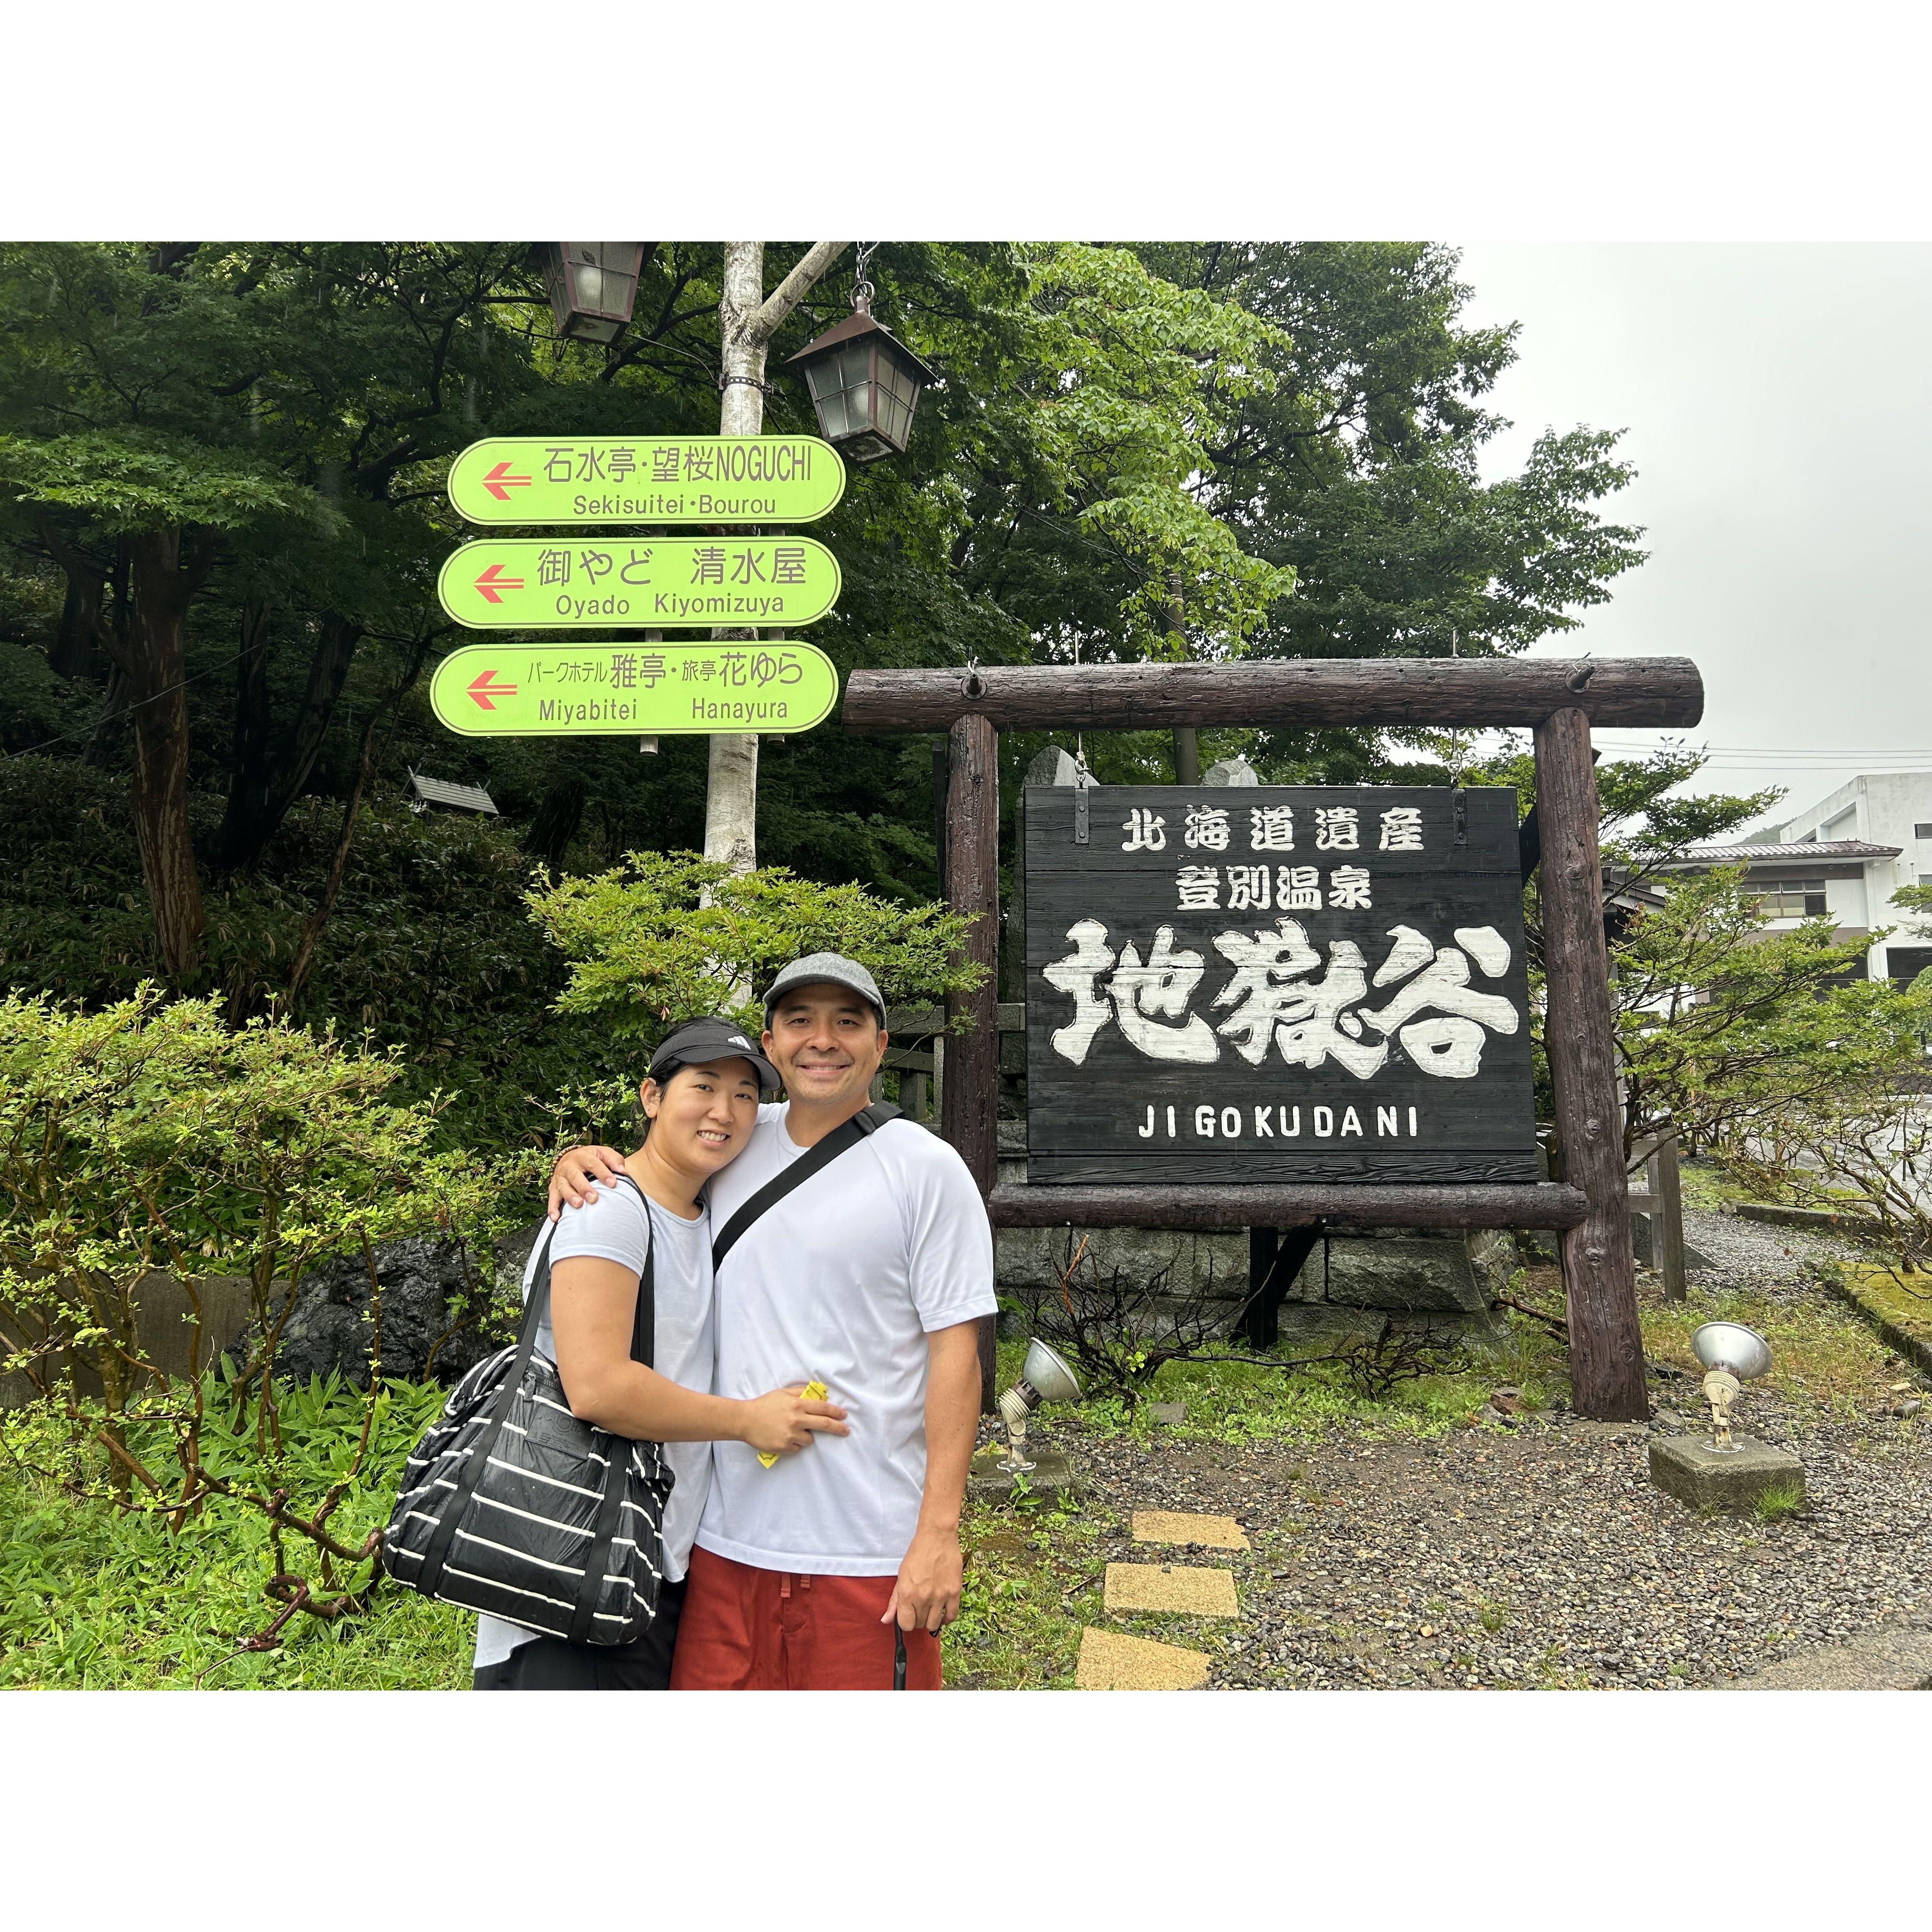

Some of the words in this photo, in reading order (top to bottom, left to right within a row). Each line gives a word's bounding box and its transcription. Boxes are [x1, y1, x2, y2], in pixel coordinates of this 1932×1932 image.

[537, 548, 653, 587] 御やど
[690, 546, 806, 585] 清水屋
[556, 595, 630, 616] Oyado
[655, 593, 783, 617] Kiyomizuya
[540, 698, 636, 723] Miyabitei
[692, 698, 787, 723] Hanayura
[1121, 804, 1425, 851] 北海道遺産
[1175, 864, 1372, 910] 登別温泉
[1042, 916, 1519, 1080] 地獄谷
